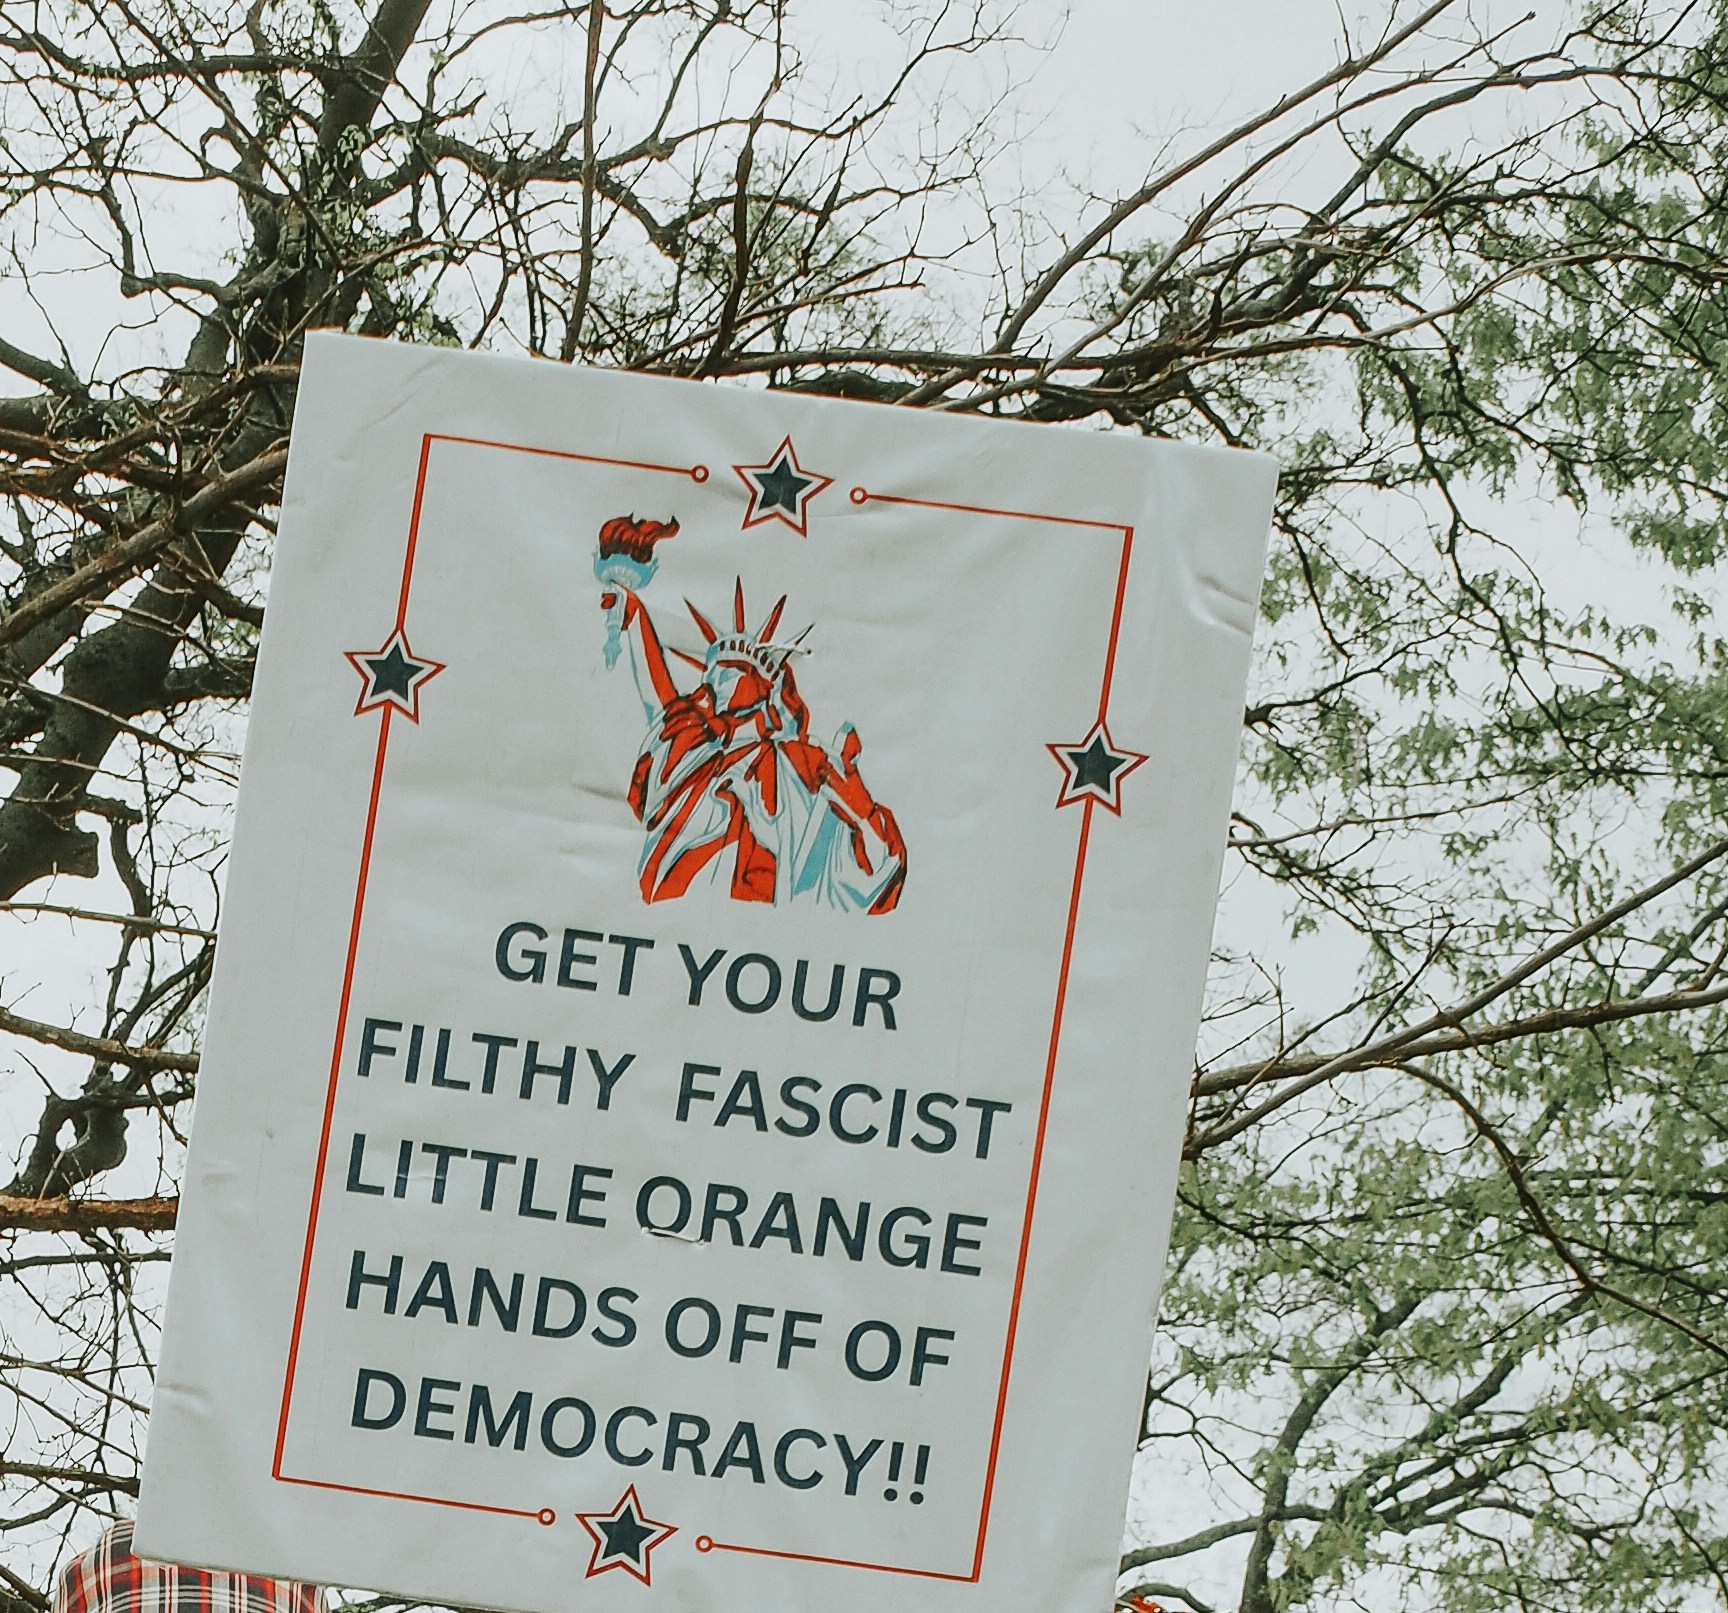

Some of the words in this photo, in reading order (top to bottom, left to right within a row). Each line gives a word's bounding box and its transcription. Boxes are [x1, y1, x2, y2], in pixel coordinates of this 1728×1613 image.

[494, 920, 657, 998] GET
[676, 942, 903, 1032] YOUR
[356, 1016, 638, 1112] FILTHY
[674, 1061, 1014, 1161] FASCIST
[344, 1131, 615, 1230] LITTLE
[634, 1174, 990, 1278] ORANGE
[344, 1248, 641, 1349] HANDS
[663, 1296, 824, 1371] OFF
[843, 1318, 957, 1388] OF
[349, 1366, 932, 1506] DEMOCRACY!!
